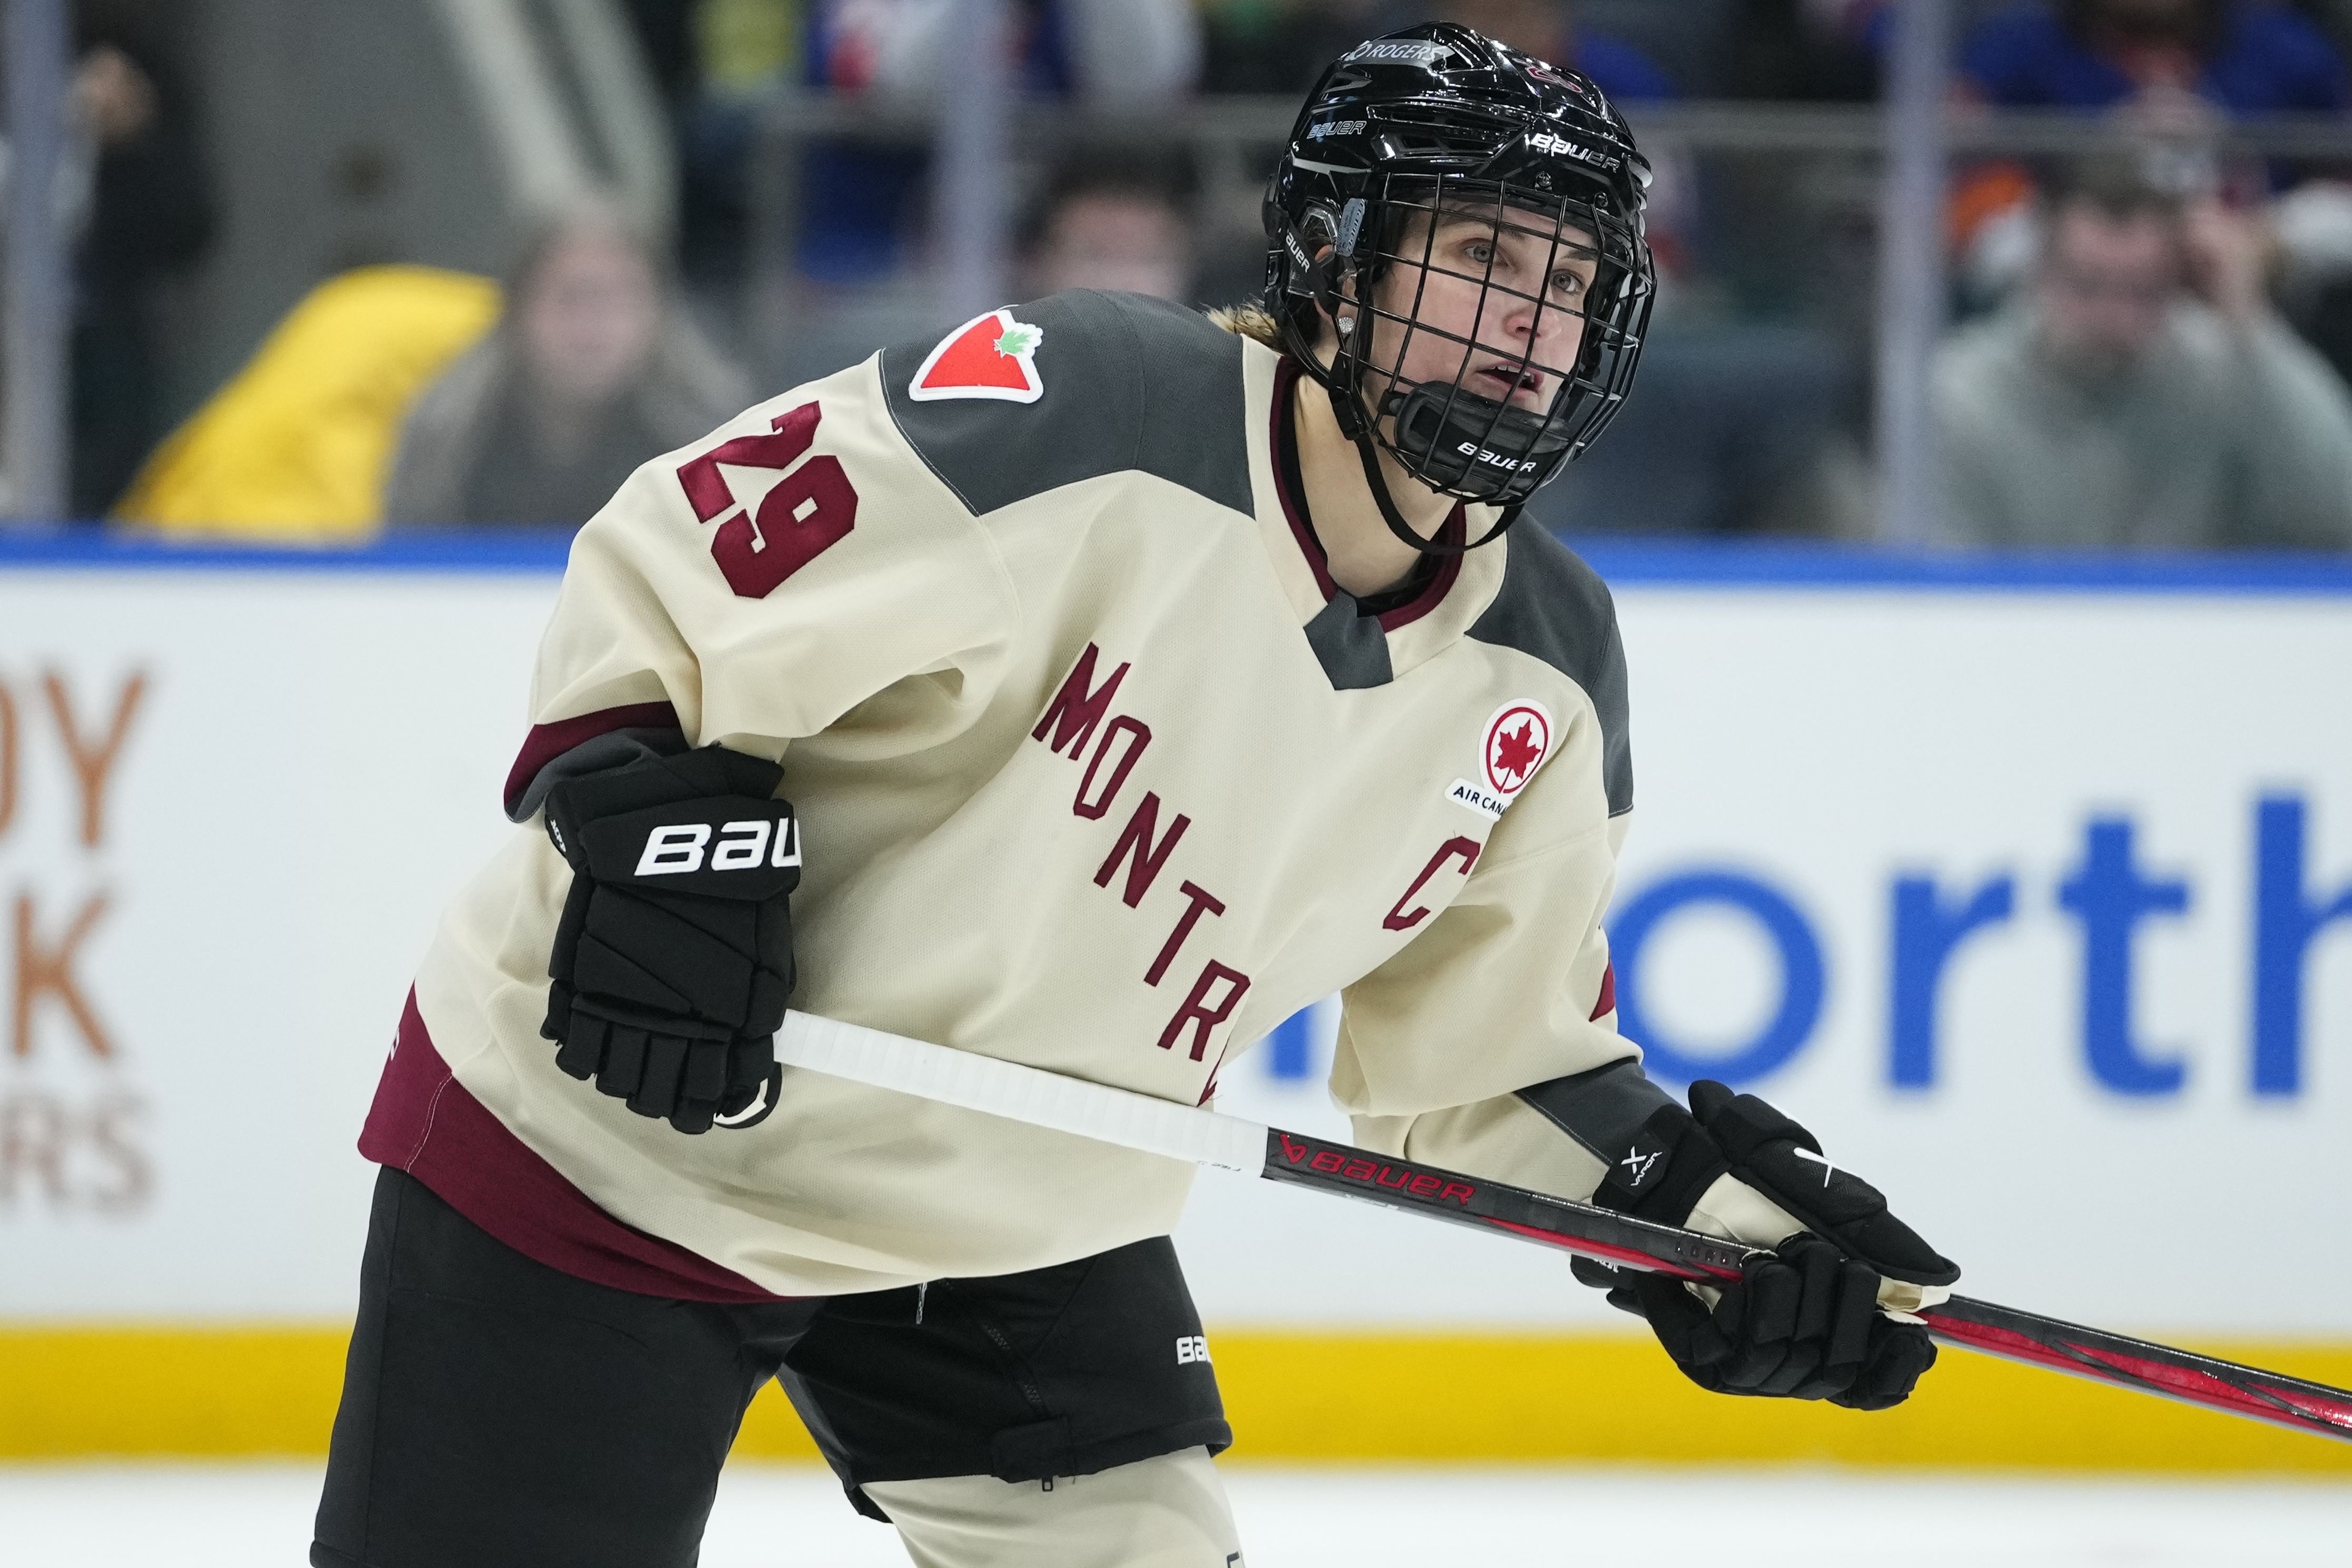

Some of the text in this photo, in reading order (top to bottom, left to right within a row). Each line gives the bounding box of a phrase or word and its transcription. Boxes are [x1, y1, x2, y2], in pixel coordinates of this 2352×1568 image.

[1371, 44, 1447, 61] ROGERS
[1306, 121, 1367, 139] BAUER
[1530, 133, 1620, 173] BAUER
[1286, 227, 1310, 273] AUER
[1457, 441, 1537, 473] BAUER
[676, 400, 858, 599] 29
[0, 666, 155, 856] Y
[1453, 786, 1480, 805] AIR
[1031, 641, 1251, 1107] MONTR
[1382, 836, 1480, 931] C
[1309, 1150, 1475, 1206] BAUER
[1629, 1151, 1663, 1187] VAPOR
